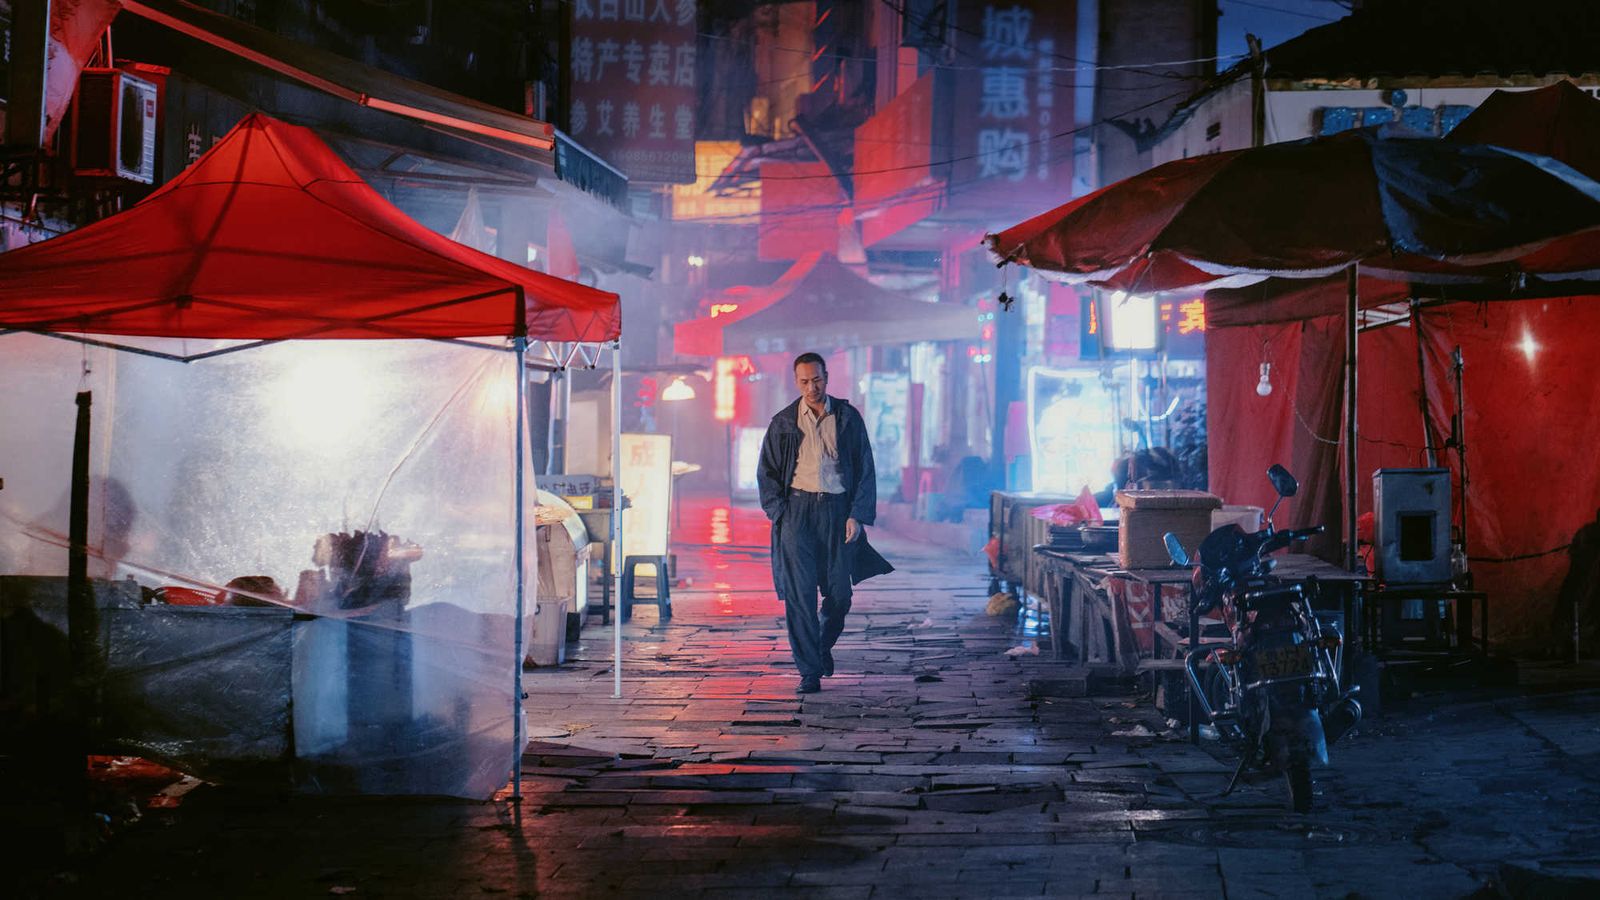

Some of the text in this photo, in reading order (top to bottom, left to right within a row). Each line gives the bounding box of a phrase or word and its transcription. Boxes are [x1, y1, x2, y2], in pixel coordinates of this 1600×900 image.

[571, 37, 696, 86] 特产专卖店
